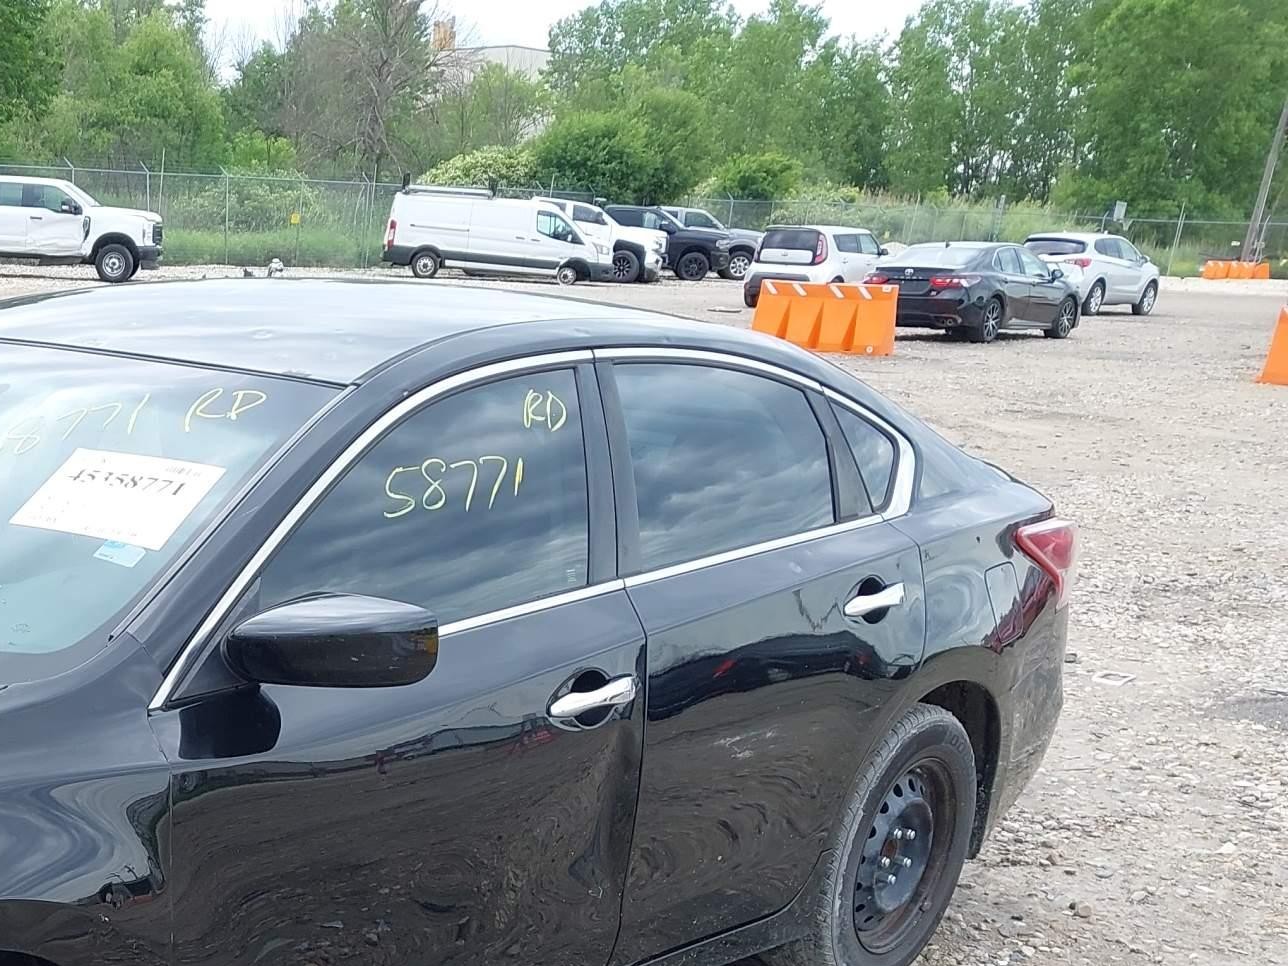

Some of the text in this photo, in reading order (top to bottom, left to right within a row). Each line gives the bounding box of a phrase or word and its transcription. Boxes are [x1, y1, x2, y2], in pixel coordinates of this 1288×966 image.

[184, 387, 268, 433] RD
[523, 389, 567, 432] RD
[66, 467, 187, 497] 45358771
[383, 455, 524, 519] 58771
